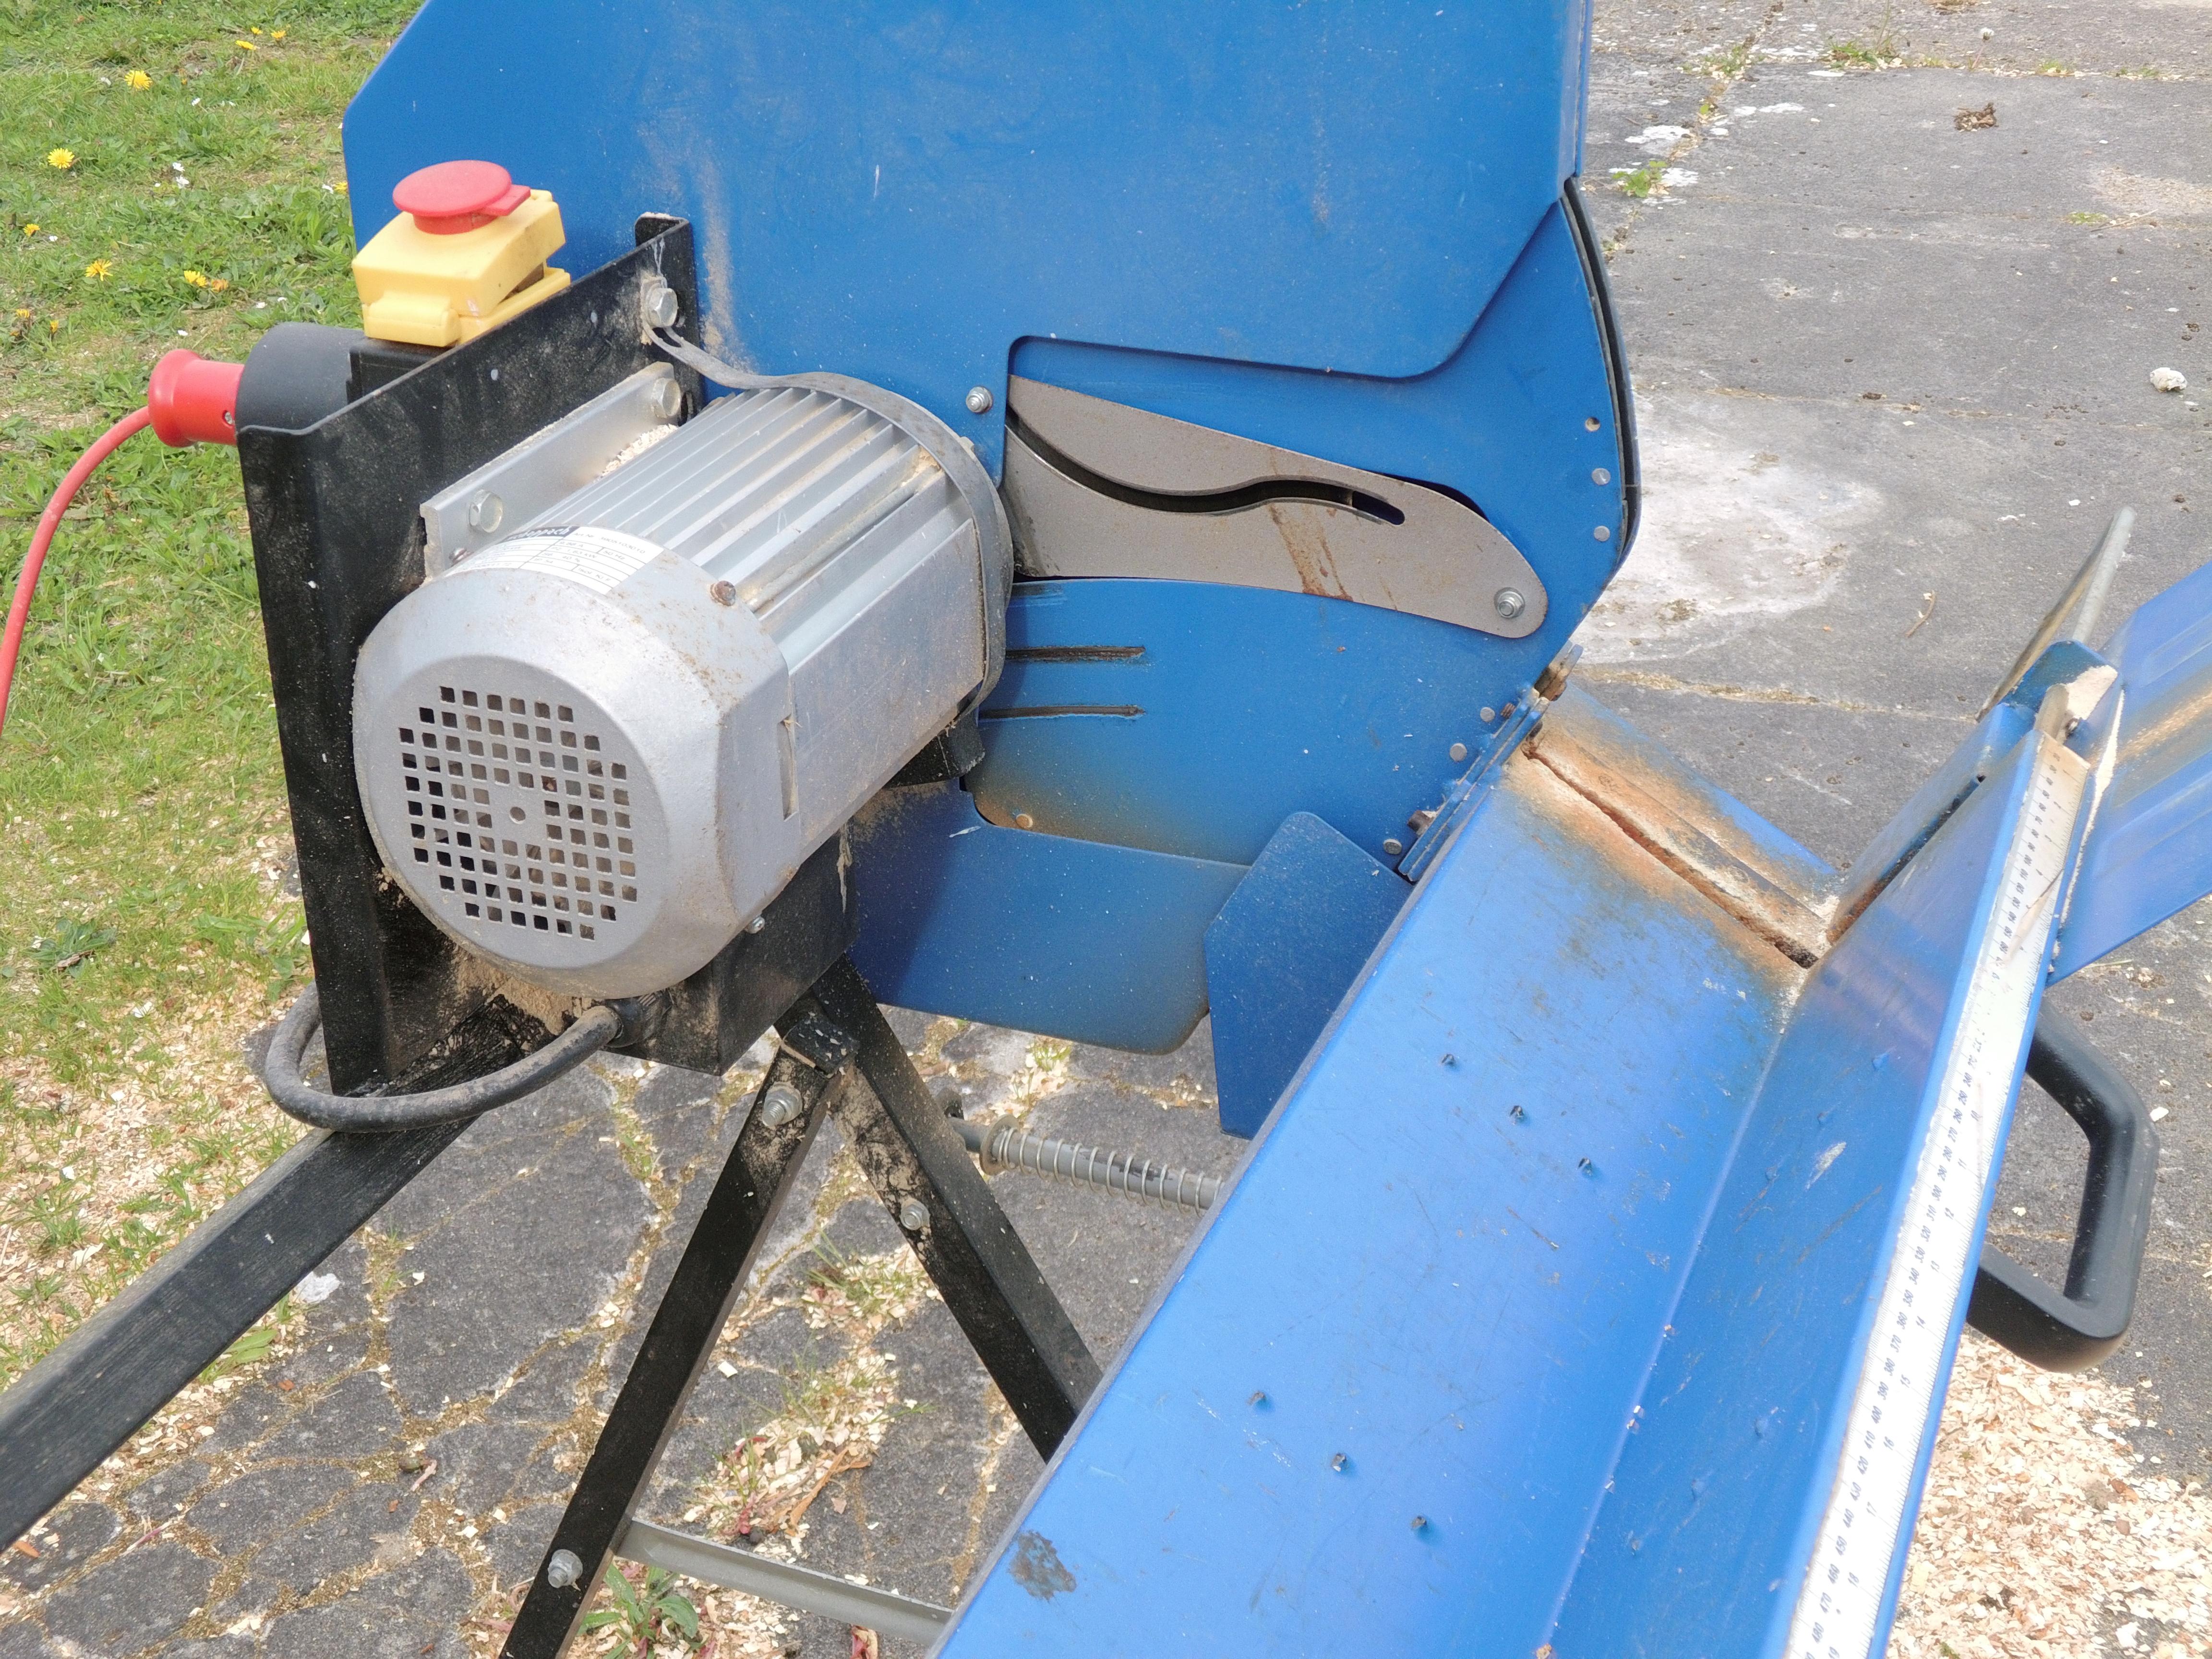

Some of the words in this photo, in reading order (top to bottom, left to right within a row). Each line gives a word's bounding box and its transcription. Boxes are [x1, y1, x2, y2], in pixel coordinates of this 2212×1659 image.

[2020, 868, 2028, 880] 110
[2016, 882, 2024, 894] 120
[1963, 1072, 1972, 1087] 240
[1958, 1090, 1968, 1106] 250
[1953, 1108, 1962, 1124] 260
[1948, 1127, 1958, 1143] 270
[1942, 1146, 1952, 1162] 280
[1958, 1158, 1967, 1169] 11
[1937, 1165, 1947, 1181] 290
[1932, 1185, 1942, 1201] 300
[1926, 1204, 1936, 1221] 310
[1945, 1207, 1954, 1220] 12
[1920, 1225, 1931, 1242] 320
[1914, 1246, 1925, 1263] 330
[1930, 1260, 1940, 1273] 13
[1909, 1267, 1919, 1285] 340
[1903, 1289, 1913, 1307] 350
[1897, 1311, 1908, 1330] 360
[1916, 1316, 1926, 1329] 14
[1890, 1334, 1901, 1353] 370
[1884, 1358, 1895, 1376] 380
[1900, 1374, 1911, 1388] 15
[1877, 1381, 1889, 1400] 390
[1871, 1406, 1882, 1424] 400
[1864, 1430, 1875, 1450] 410
[1883, 1436, 1894, 1451] 16
[1857, 1455, 1869, 1475] 420
[1866, 1501, 1877, 1517] 17
[1843, 1508, 1854, 1528] 440
[1835, 1536, 1847, 1556] 450
[1827, 1563, 1840, 1584] 460
[1848, 1572, 1859, 1588] 18
[1820, 1592, 1832, 1613] 470
[1812, 1622, 1824, 1644] 480
